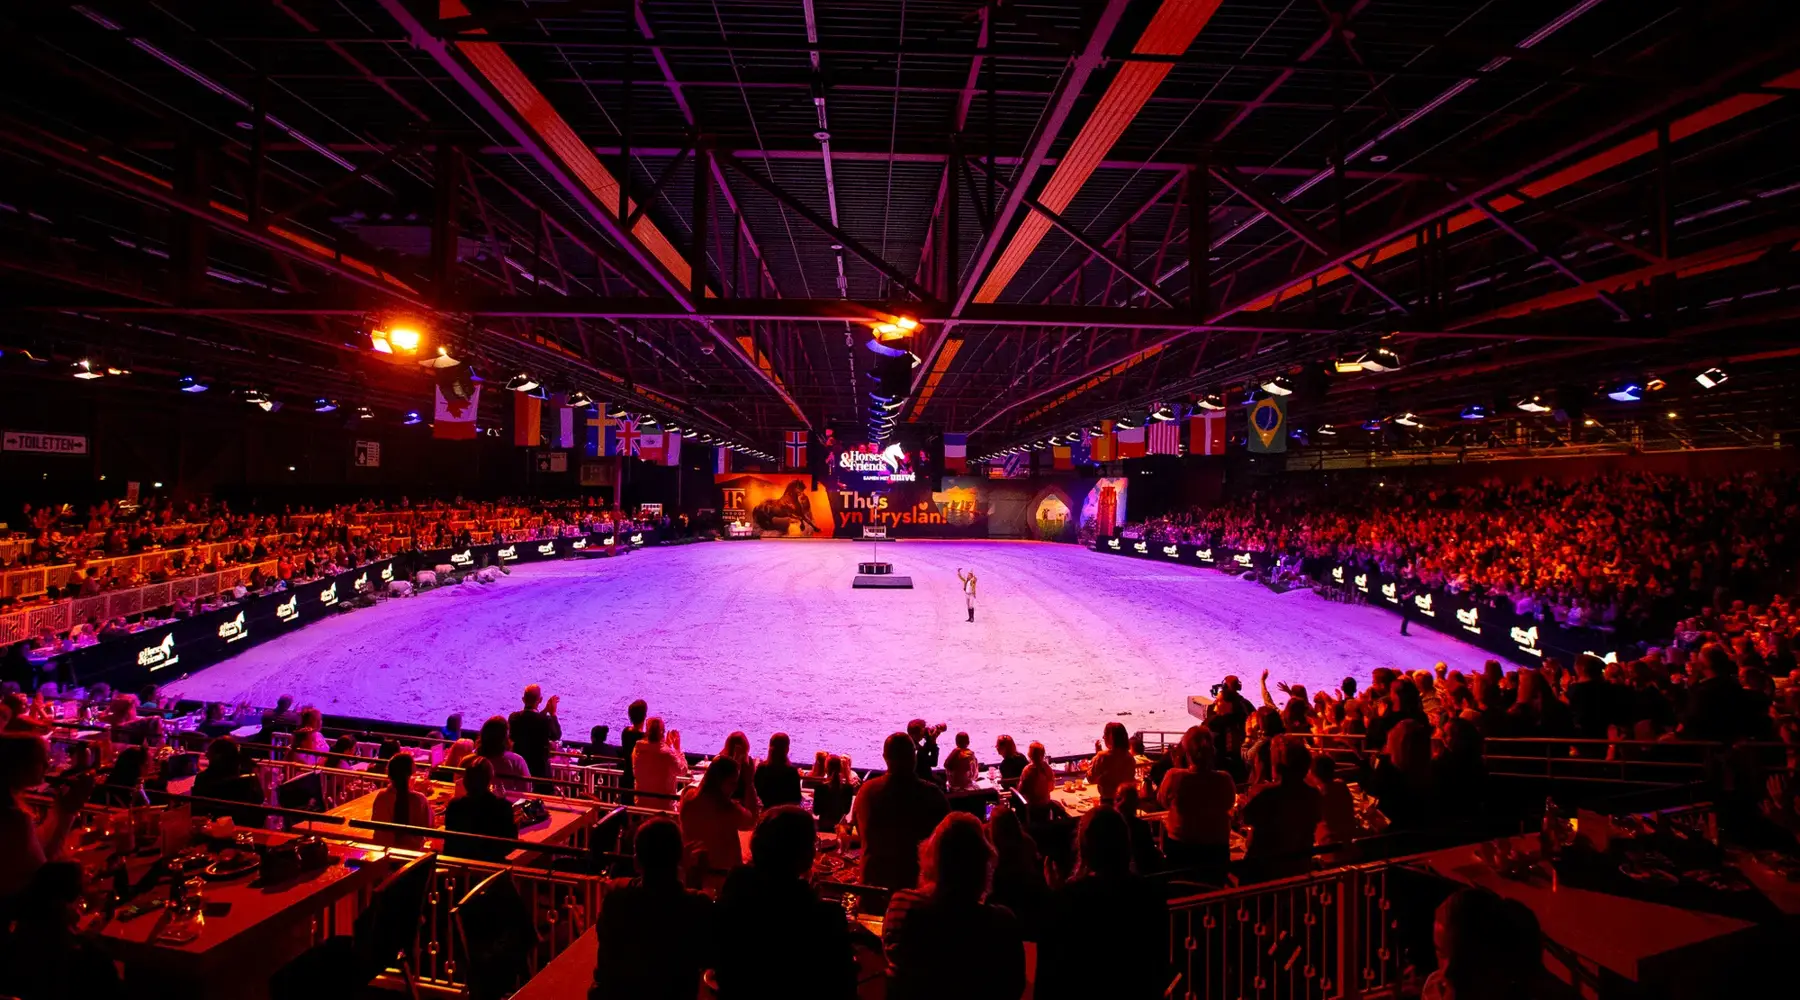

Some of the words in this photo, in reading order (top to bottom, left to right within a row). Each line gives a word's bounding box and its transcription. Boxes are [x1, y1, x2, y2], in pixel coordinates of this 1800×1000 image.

[19, 435, 74, 450] TOILETTEN
[849, 460, 887, 471] Friends
[839, 511, 864, 529] yn
